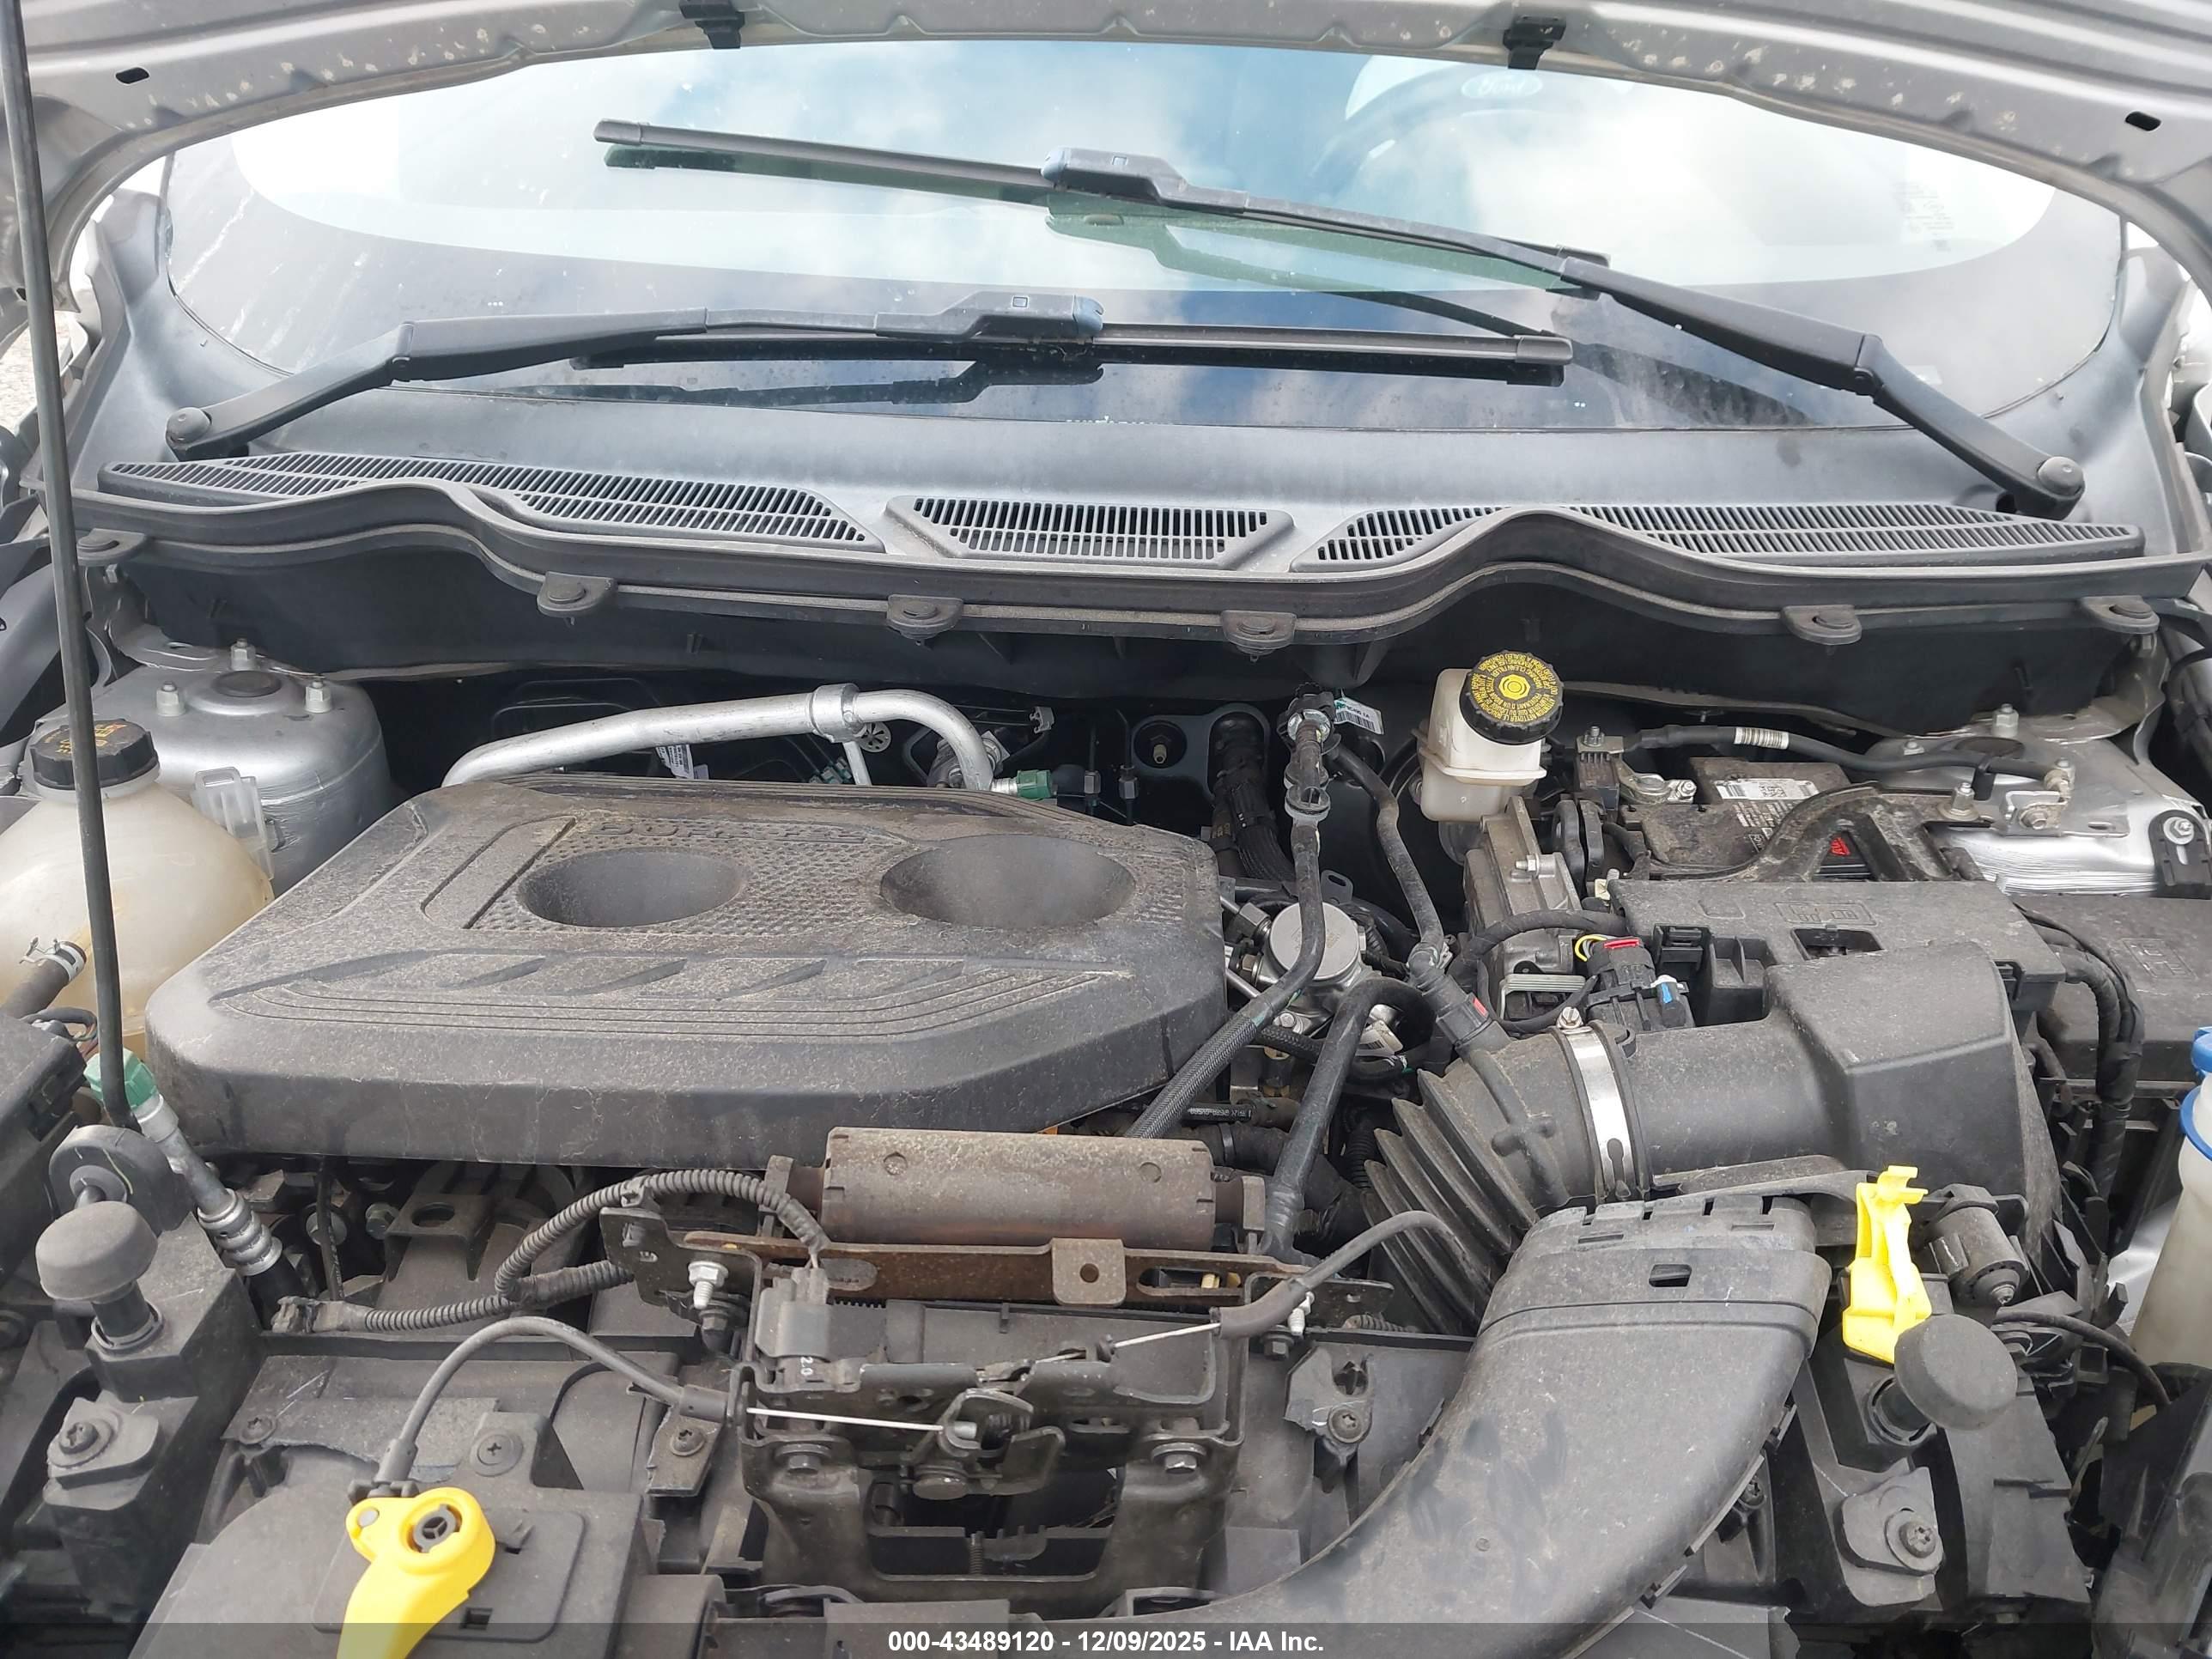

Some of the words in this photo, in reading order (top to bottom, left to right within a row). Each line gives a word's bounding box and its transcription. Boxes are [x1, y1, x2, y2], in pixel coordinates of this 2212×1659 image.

[1530, 659, 1547, 671] FROM
[1491, 665, 1507, 678] FILLER
[1544, 669, 1554, 681] FLUID
[1480, 702, 1502, 719] BOUCHON
[1490, 703, 1509, 714] LIQUIDE
[1536, 699, 1556, 717] ATTENTION
[1510, 713, 1536, 722] NETTOYER
